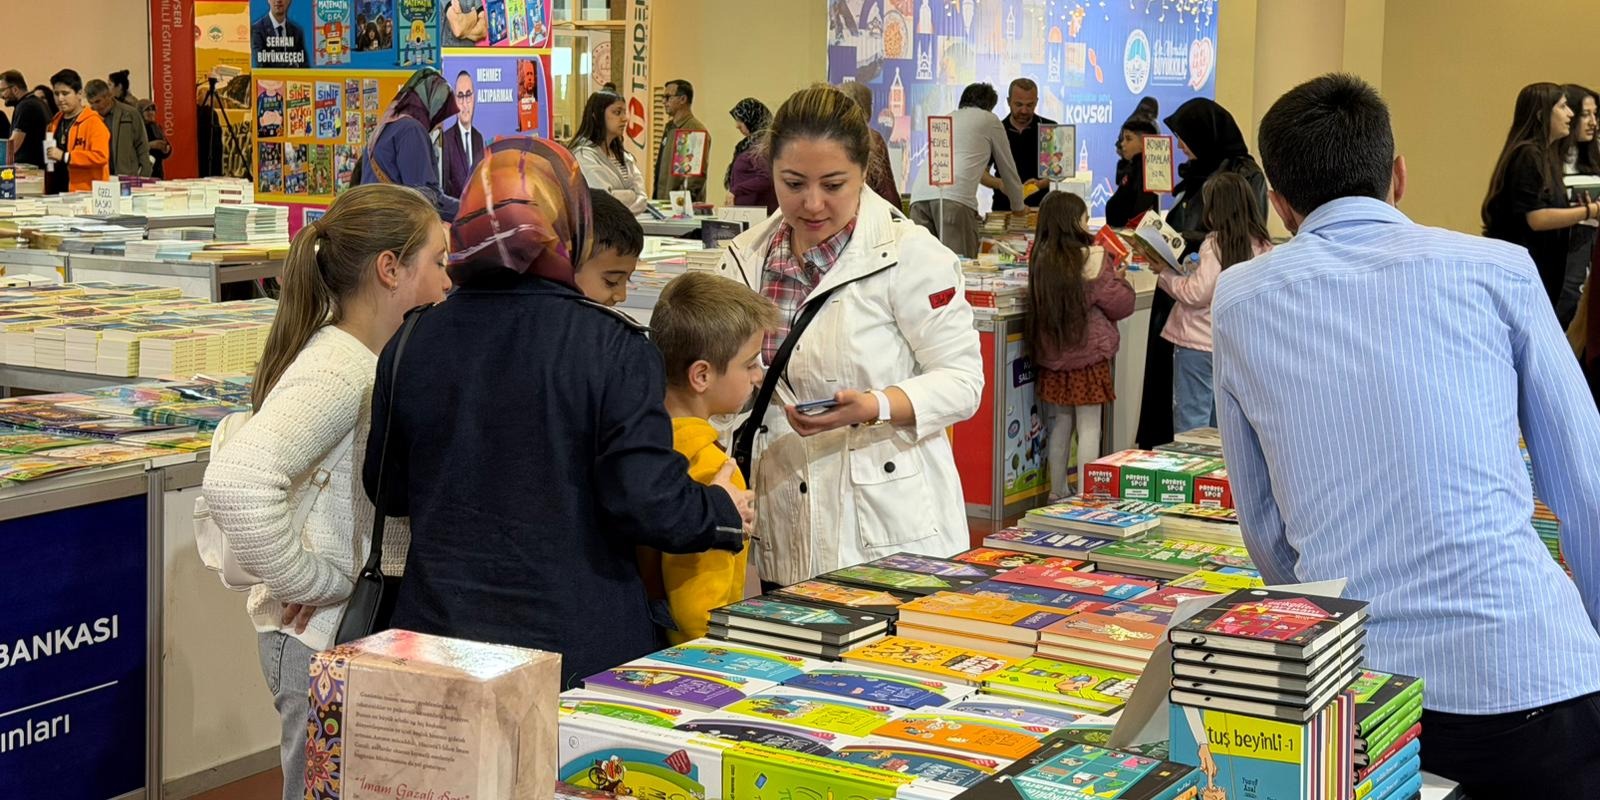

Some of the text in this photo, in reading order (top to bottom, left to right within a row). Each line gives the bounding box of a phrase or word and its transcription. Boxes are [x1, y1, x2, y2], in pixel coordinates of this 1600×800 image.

[266, 36, 294, 48] SERHAN
[1207, 727, 1231, 749] tuş
[1234, 729, 1282, 753] beyinli
